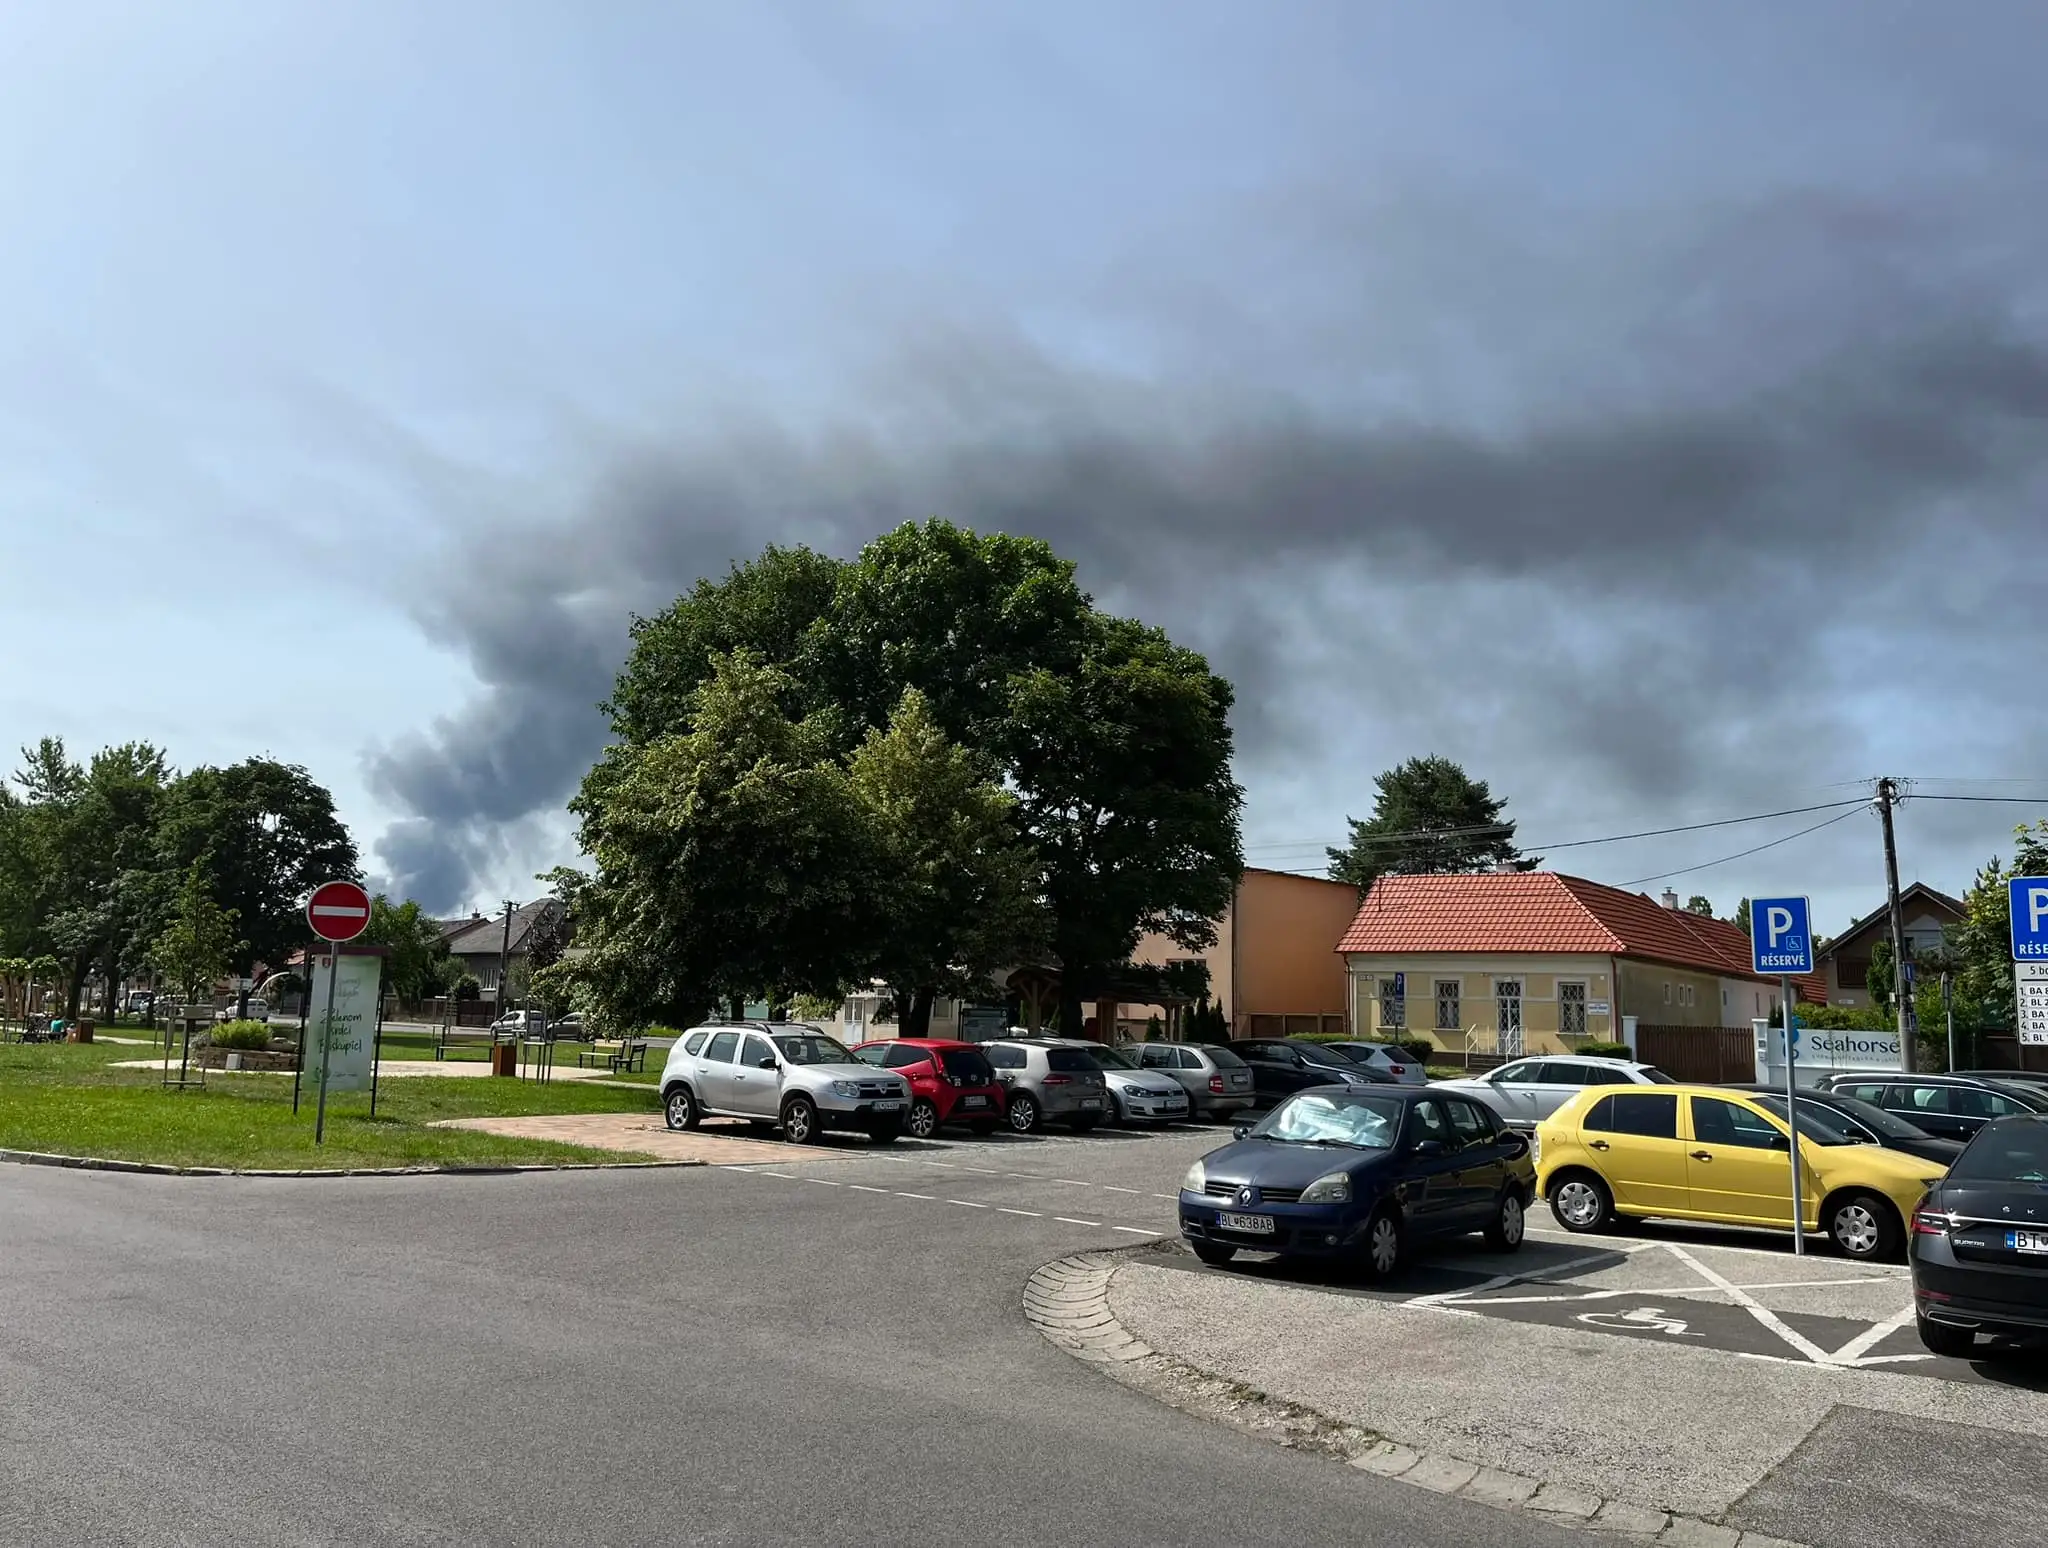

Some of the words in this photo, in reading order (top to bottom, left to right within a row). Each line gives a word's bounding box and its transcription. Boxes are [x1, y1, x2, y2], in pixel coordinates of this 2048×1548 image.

[2028, 888, 2048, 932] P
[1767, 907, 1793, 948] P
[1761, 952, 1805, 966] RÉSERVÉ
[2030, 965, 2036, 975] 5
[2029, 987, 2043, 995] BA
[2031, 1010, 2045, 1018] BA
[2032, 1022, 2045, 1030] BA
[2033, 1034, 2044, 1042] BL
[1811, 1035, 1901, 1054] Seahorse
